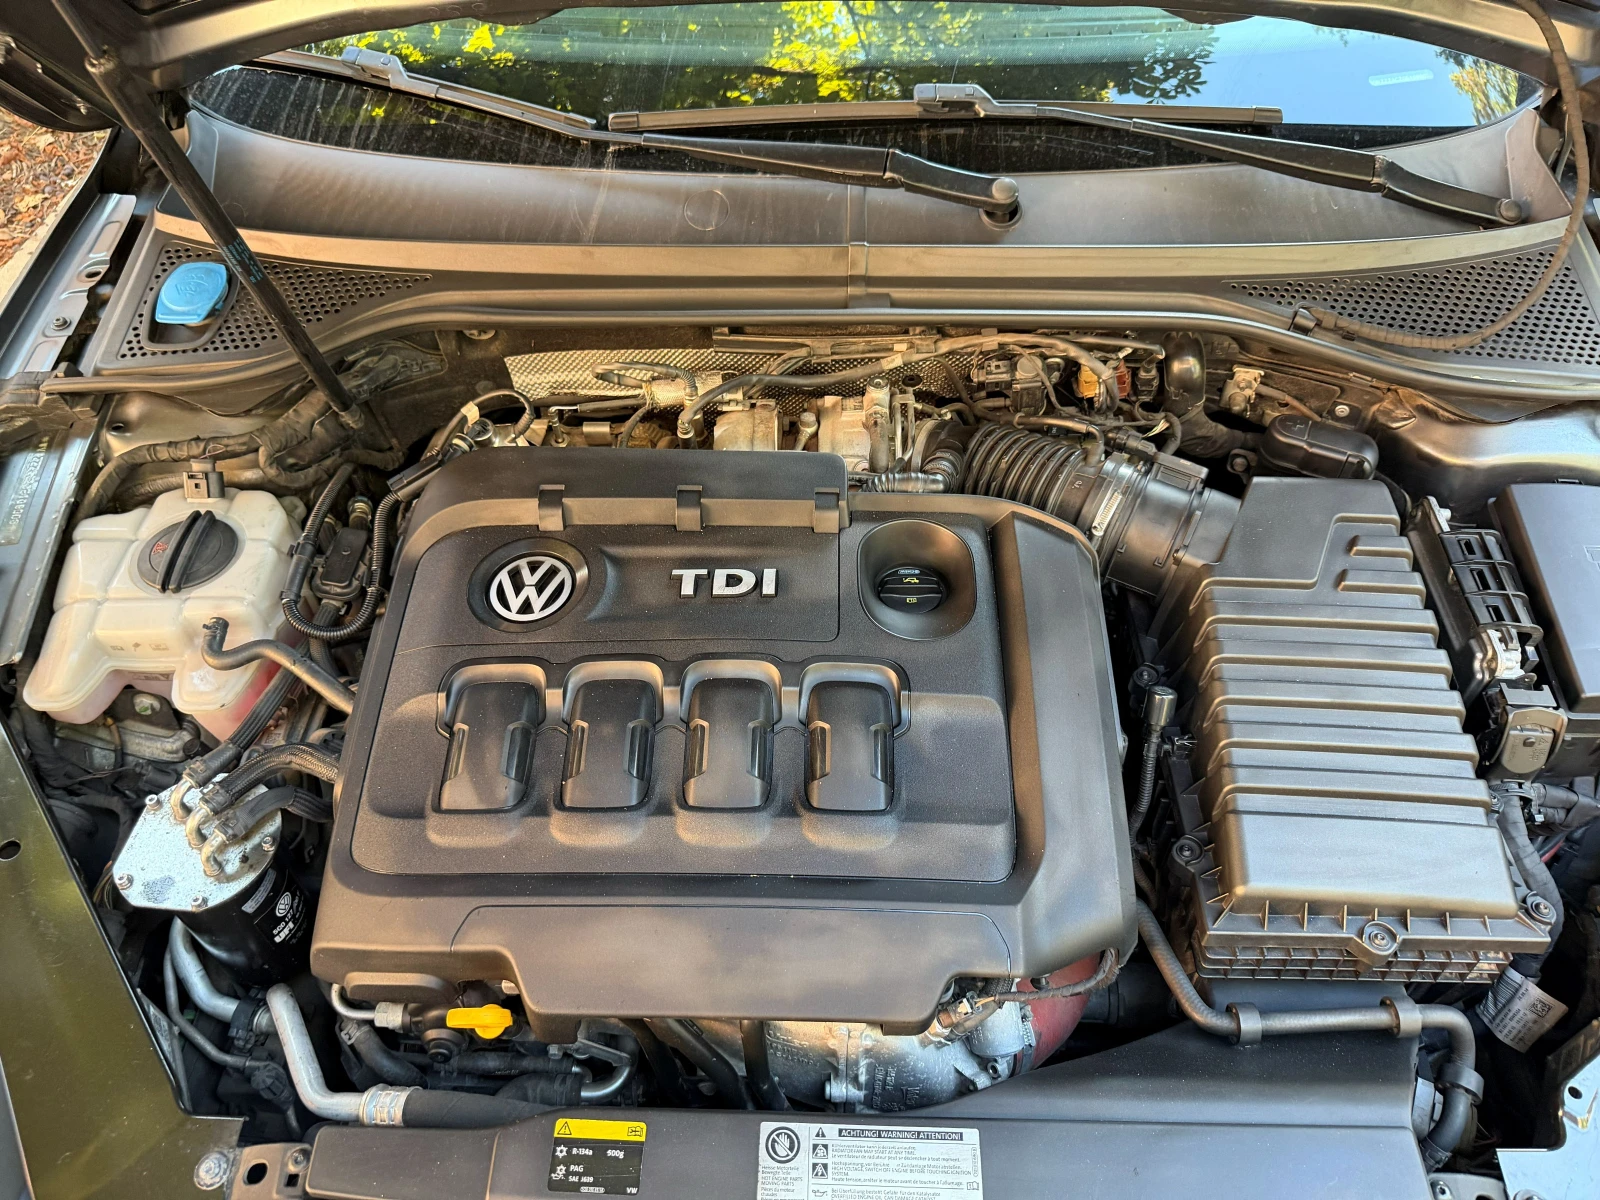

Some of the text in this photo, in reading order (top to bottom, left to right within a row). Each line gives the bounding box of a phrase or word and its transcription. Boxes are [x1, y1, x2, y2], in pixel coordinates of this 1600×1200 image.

[670, 568, 777, 598] TDI
[274, 921, 295, 943] UFI
[841, 1129, 961, 1140] ACHTUNG! WARNING! ATTENTION!
[572, 1147, 625, 1159] R-134a 500g
[569, 1164, 584, 1172] PAG
